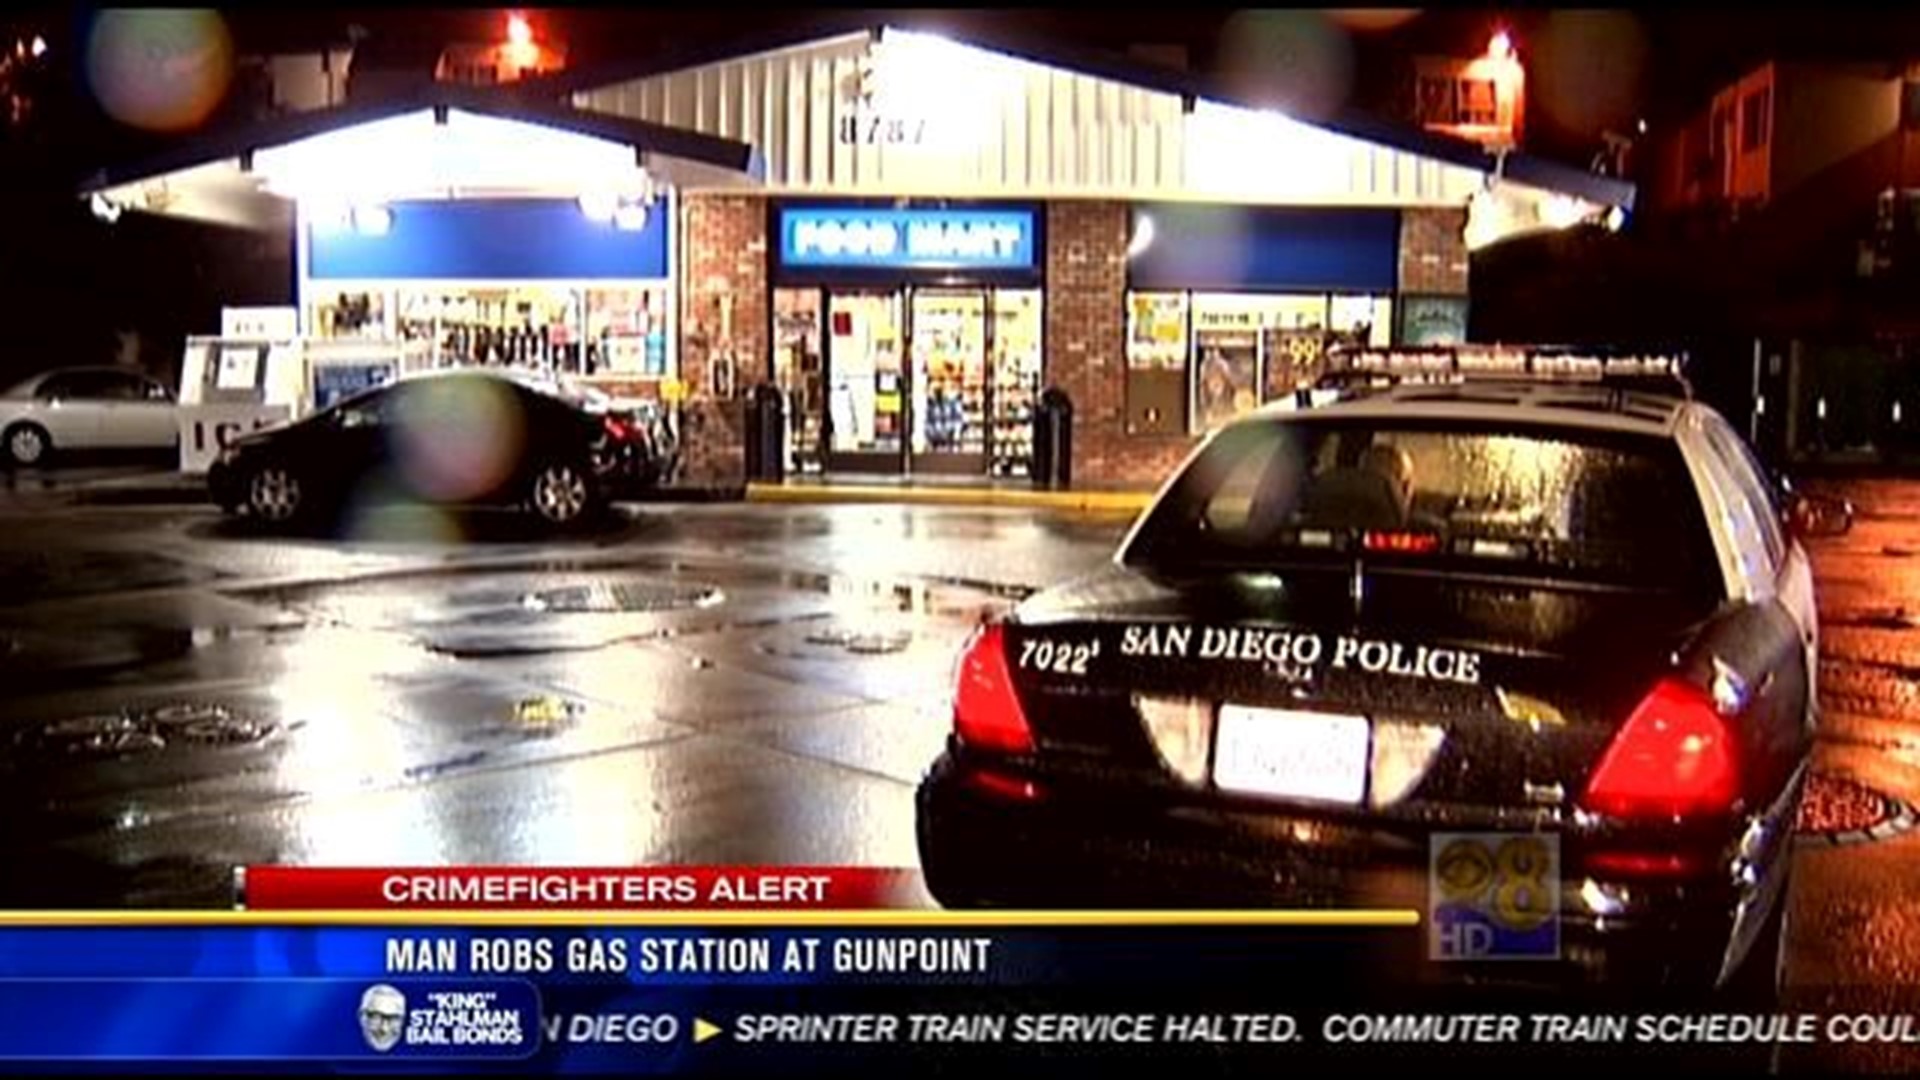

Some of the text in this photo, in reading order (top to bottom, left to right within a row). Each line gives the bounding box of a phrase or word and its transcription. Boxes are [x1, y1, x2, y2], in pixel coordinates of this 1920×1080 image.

[840, 115, 925, 145] 8787
[793, 218, 1025, 258] FOOD MART
[1120, 625, 1481, 684] SAN DIEGO POLICE
